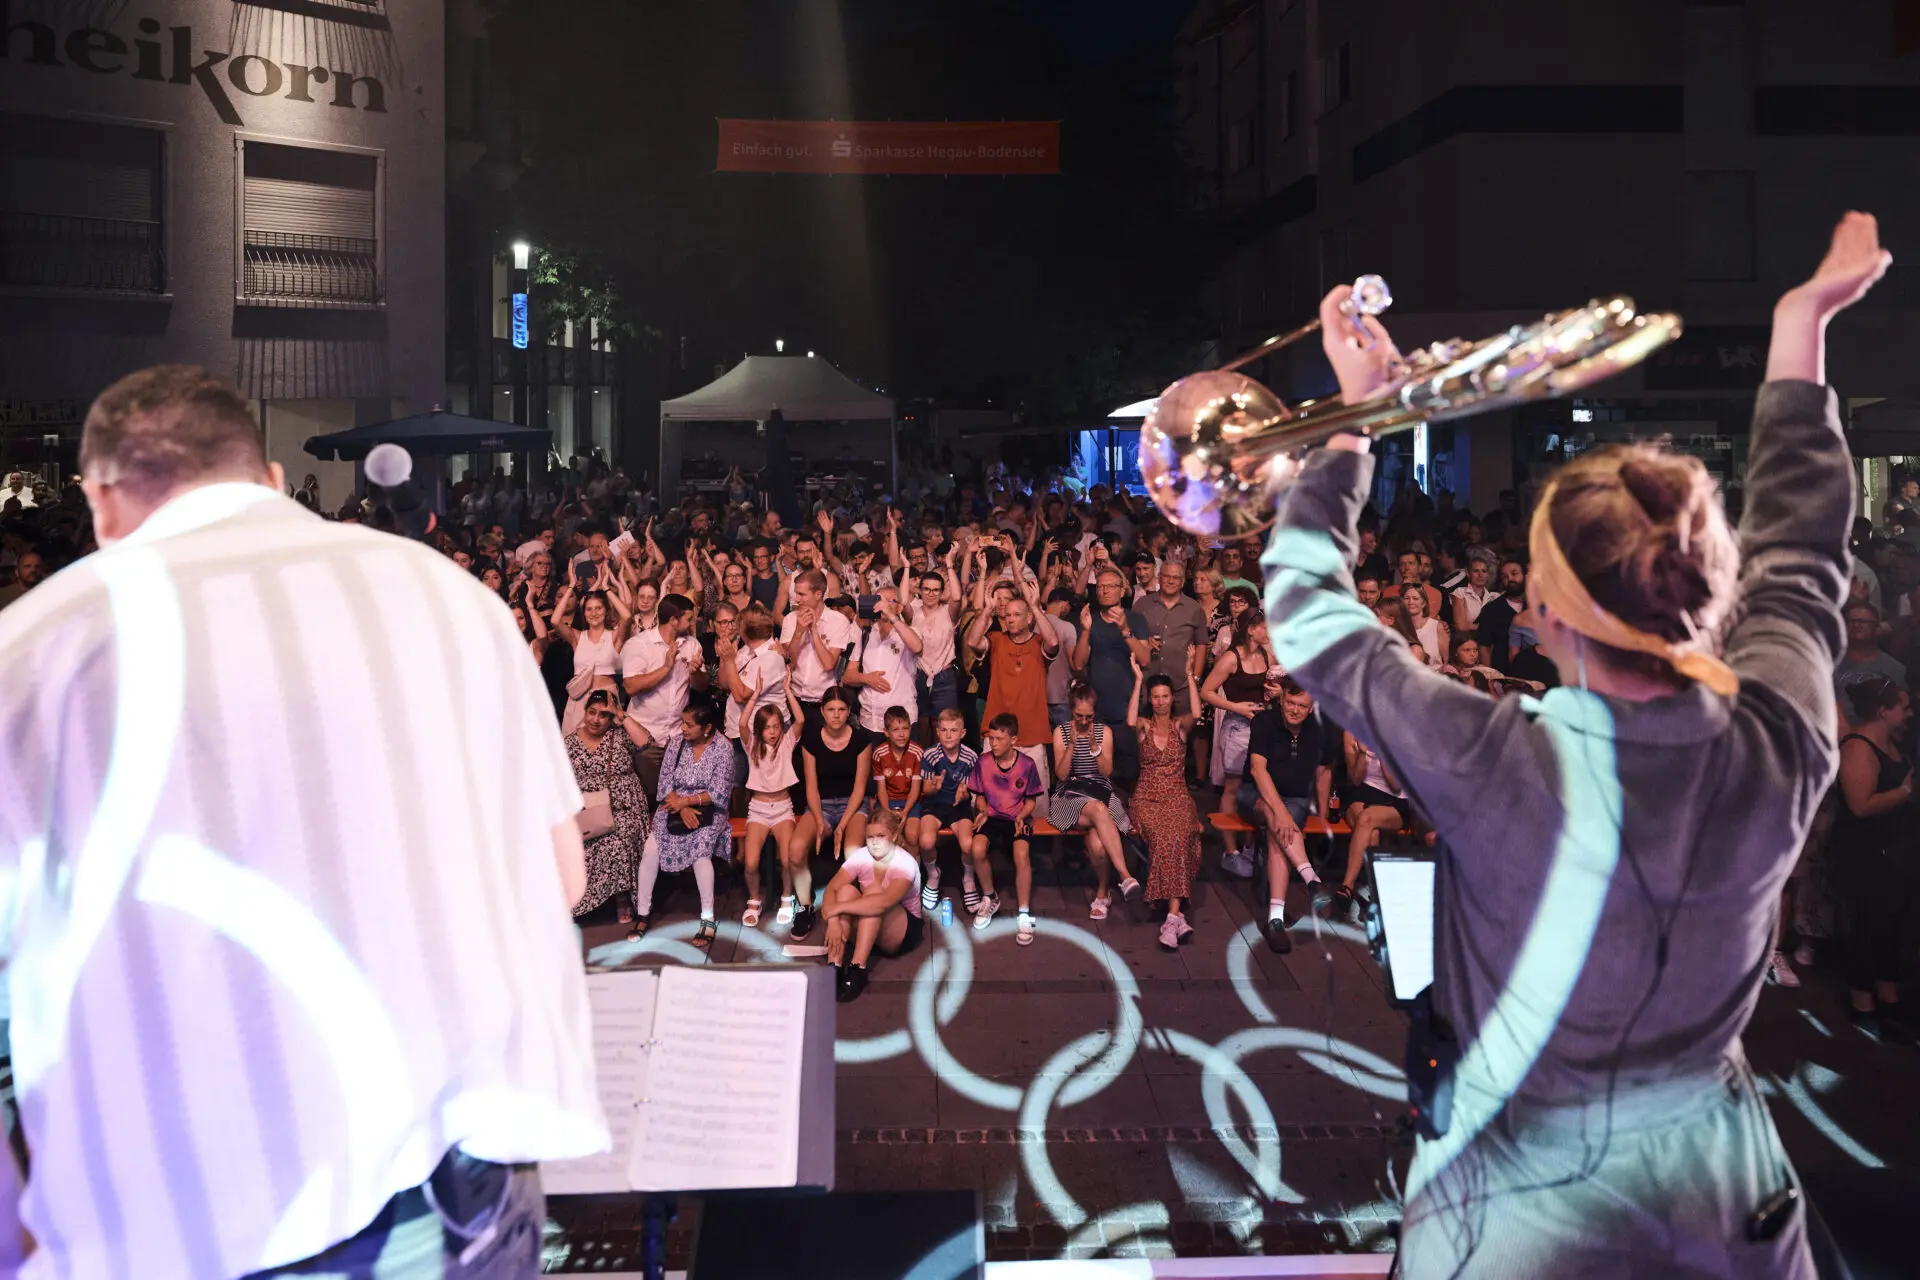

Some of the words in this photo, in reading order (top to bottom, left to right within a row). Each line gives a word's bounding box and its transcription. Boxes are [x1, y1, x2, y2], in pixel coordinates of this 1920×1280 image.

[732, 142, 782, 157] Einfach
[786, 143, 813, 159] gut.
[855, 145, 924, 159] Sparkasse
[928, 146, 1045, 160] Hegau-Bodensee
